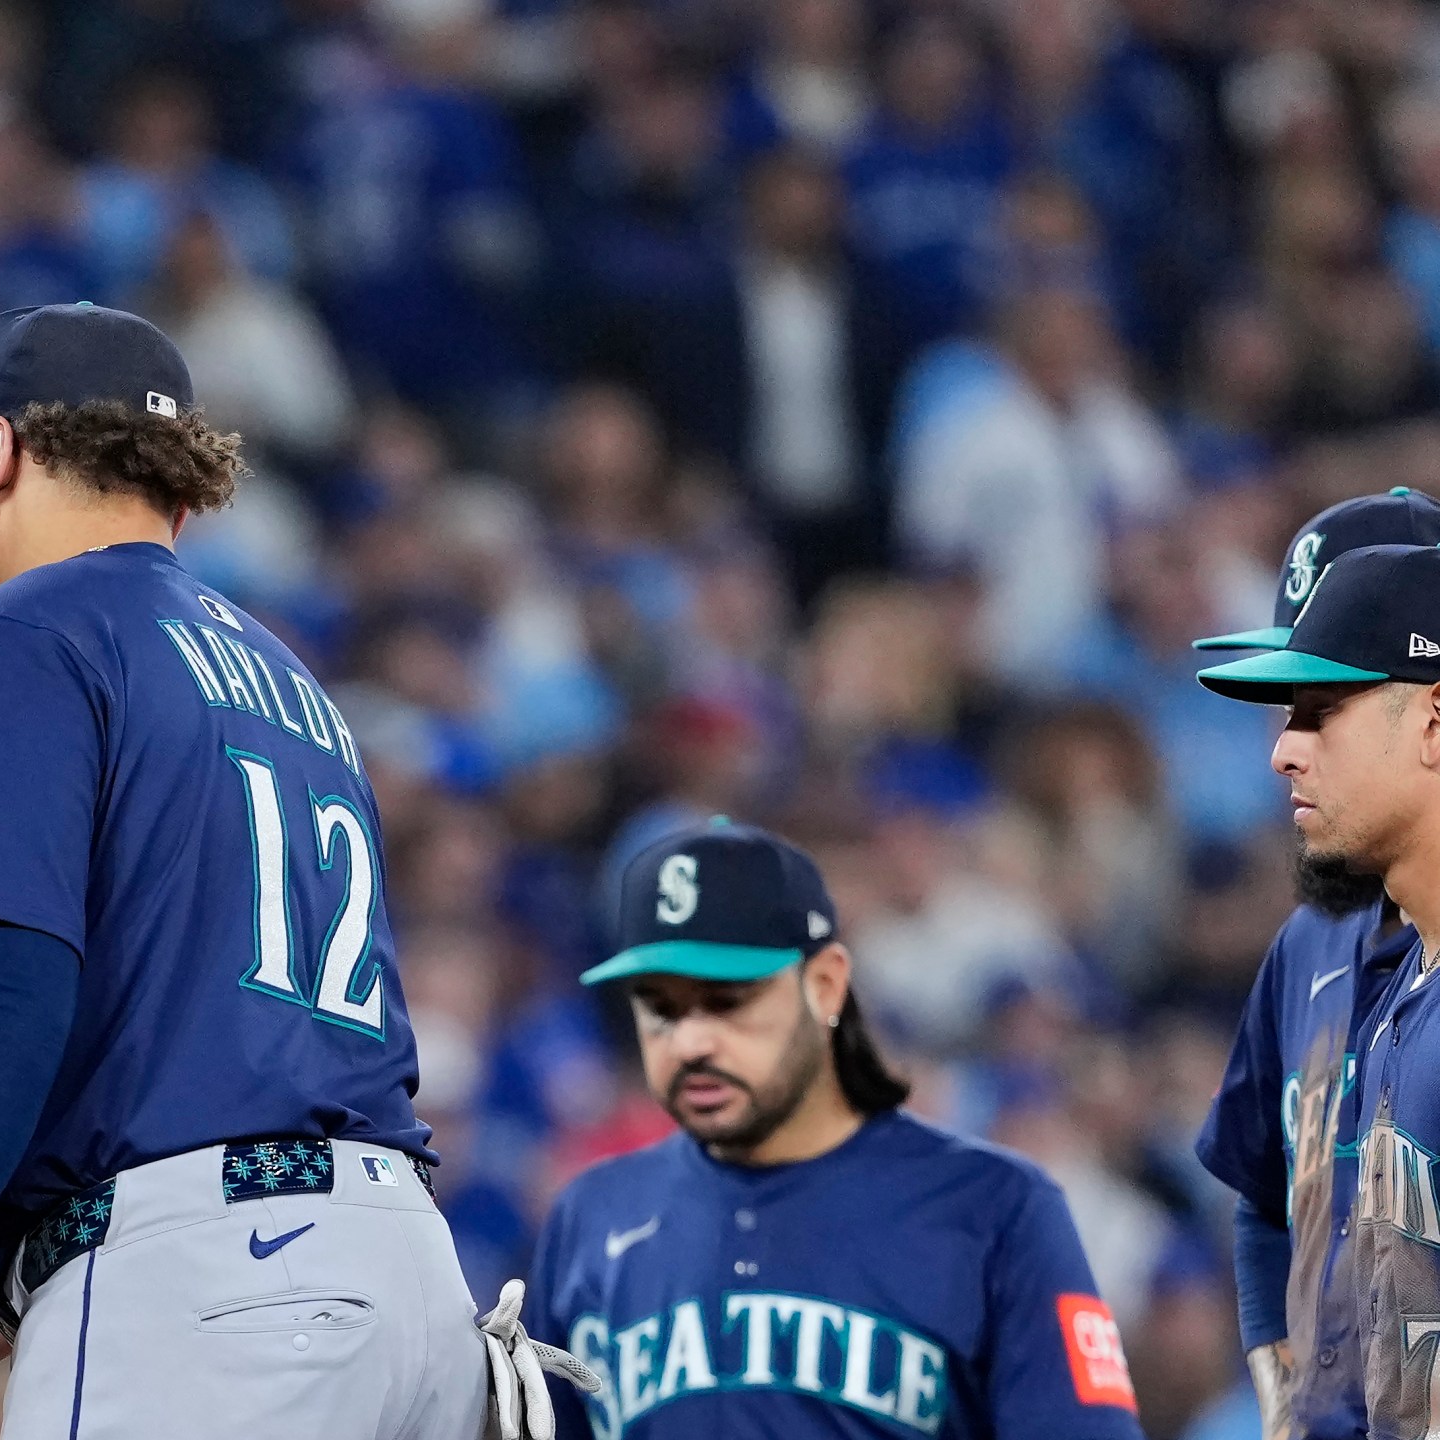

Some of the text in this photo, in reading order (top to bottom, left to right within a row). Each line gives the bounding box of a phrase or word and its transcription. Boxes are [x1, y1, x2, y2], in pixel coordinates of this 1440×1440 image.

[158, 618, 363, 785] NAYLOR
[225, 744, 386, 1043] 12
[656, 854, 700, 924] S
